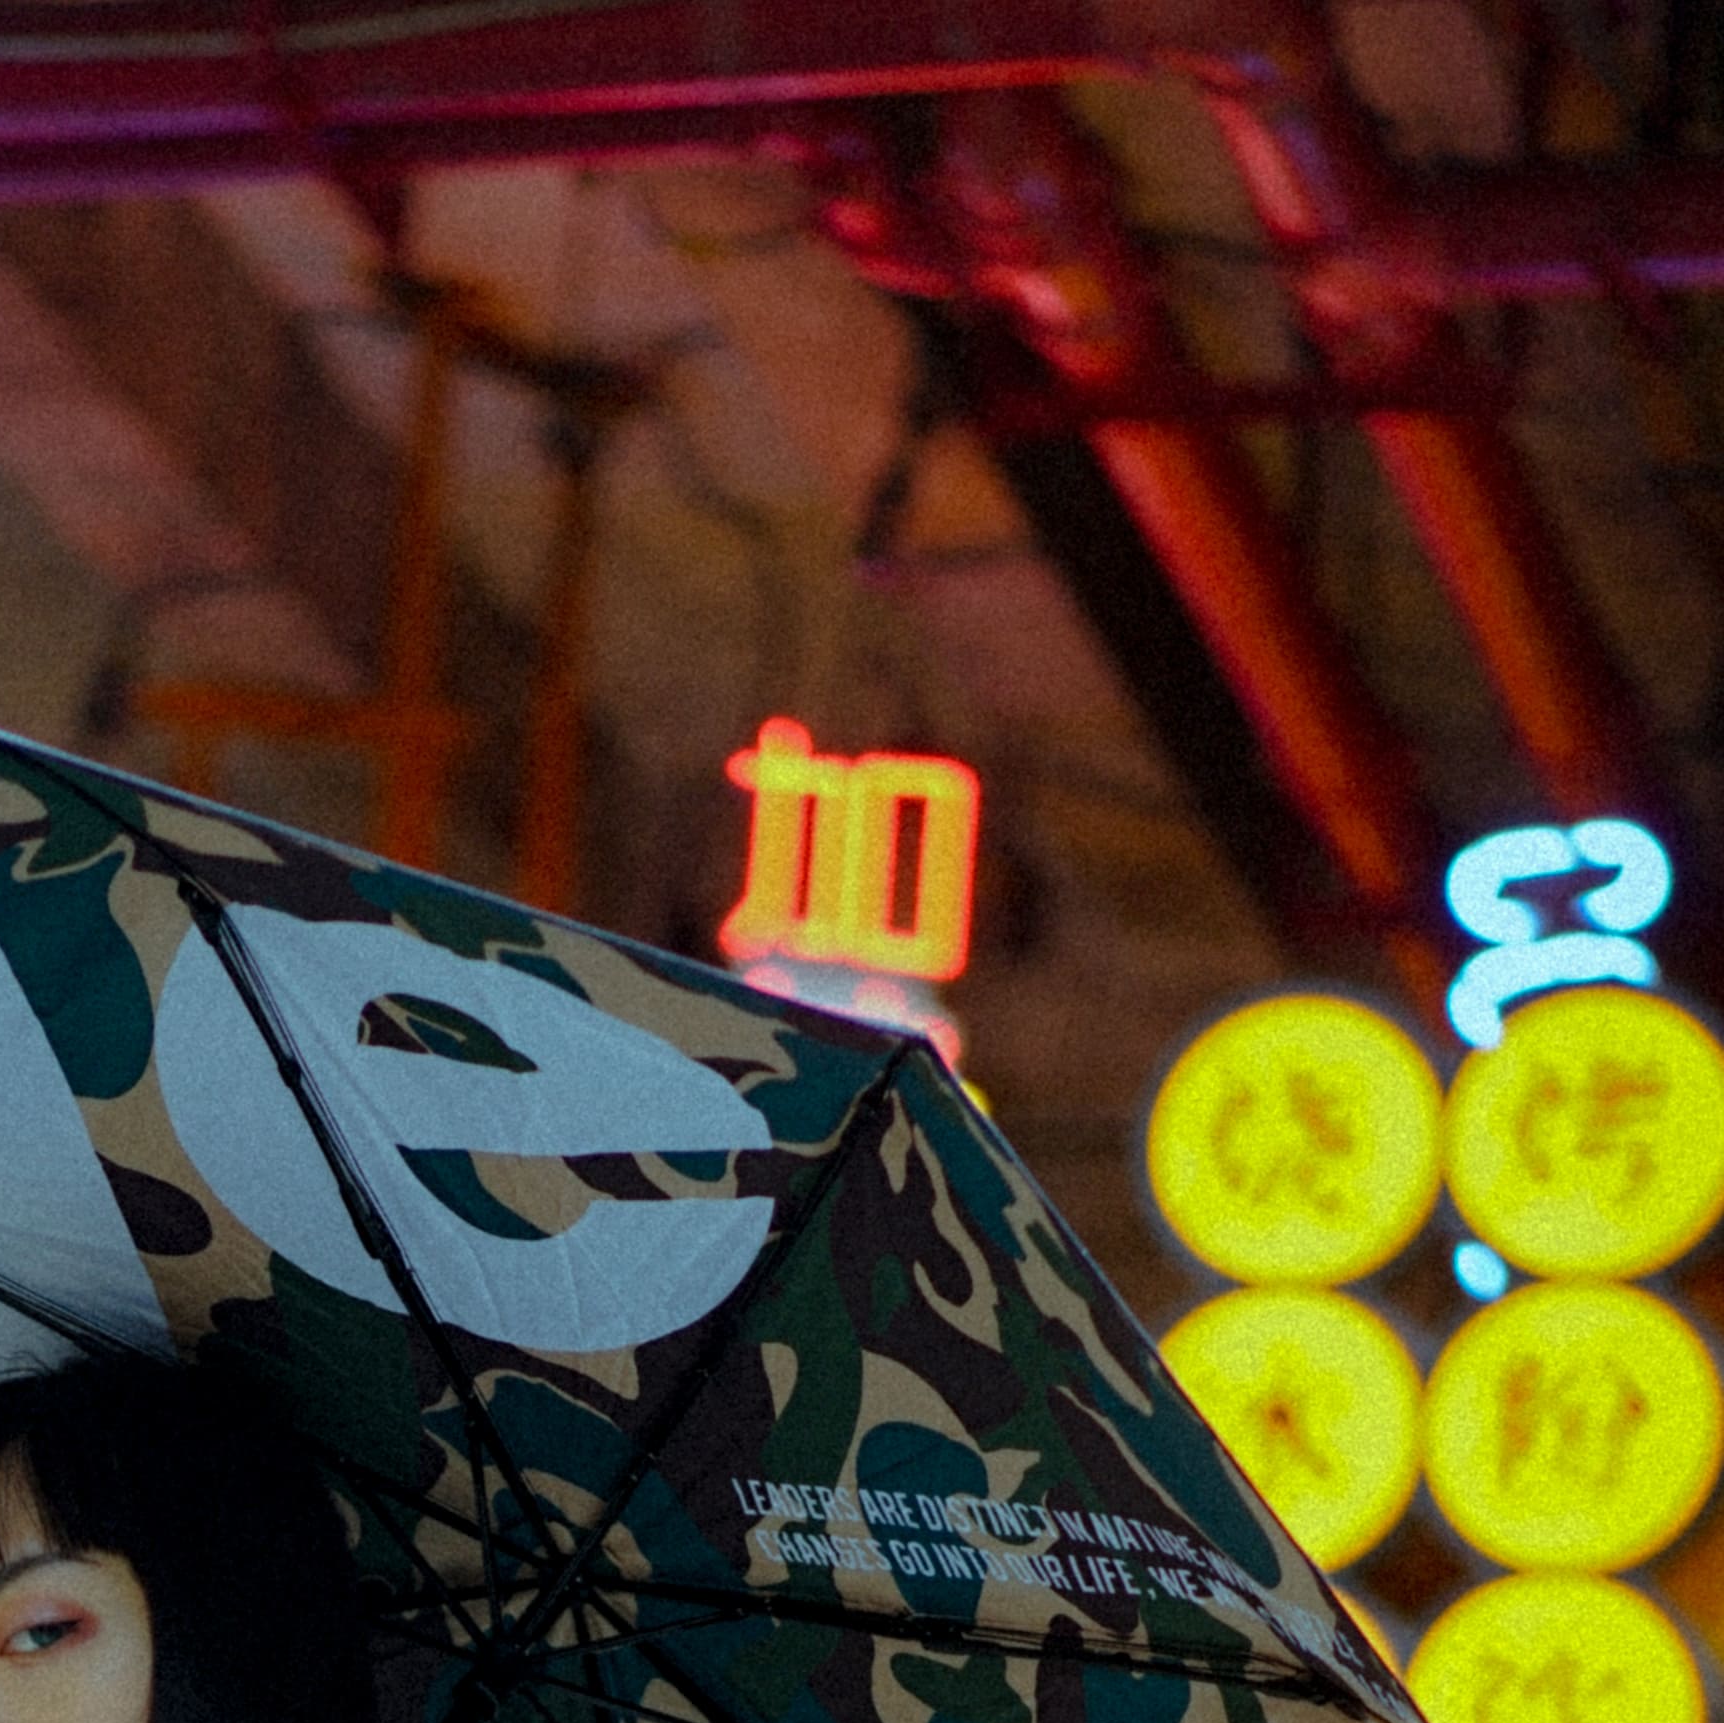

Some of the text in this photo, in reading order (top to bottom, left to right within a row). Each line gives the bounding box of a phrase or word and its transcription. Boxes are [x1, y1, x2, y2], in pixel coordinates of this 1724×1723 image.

[731, 1478, 861, 1522] LEADERS
[858, 1488, 921, 1530] ARE
[915, 1494, 1059, 1539] DISTINCT
[755, 1529, 894, 1573] CHANGES
[888, 1539, 938, 1578] GO
[929, 1542, 1009, 1583] INTO
[1003, 1552, 1073, 1591] OUR
[1147, 1566, 1205, 1605] WE
